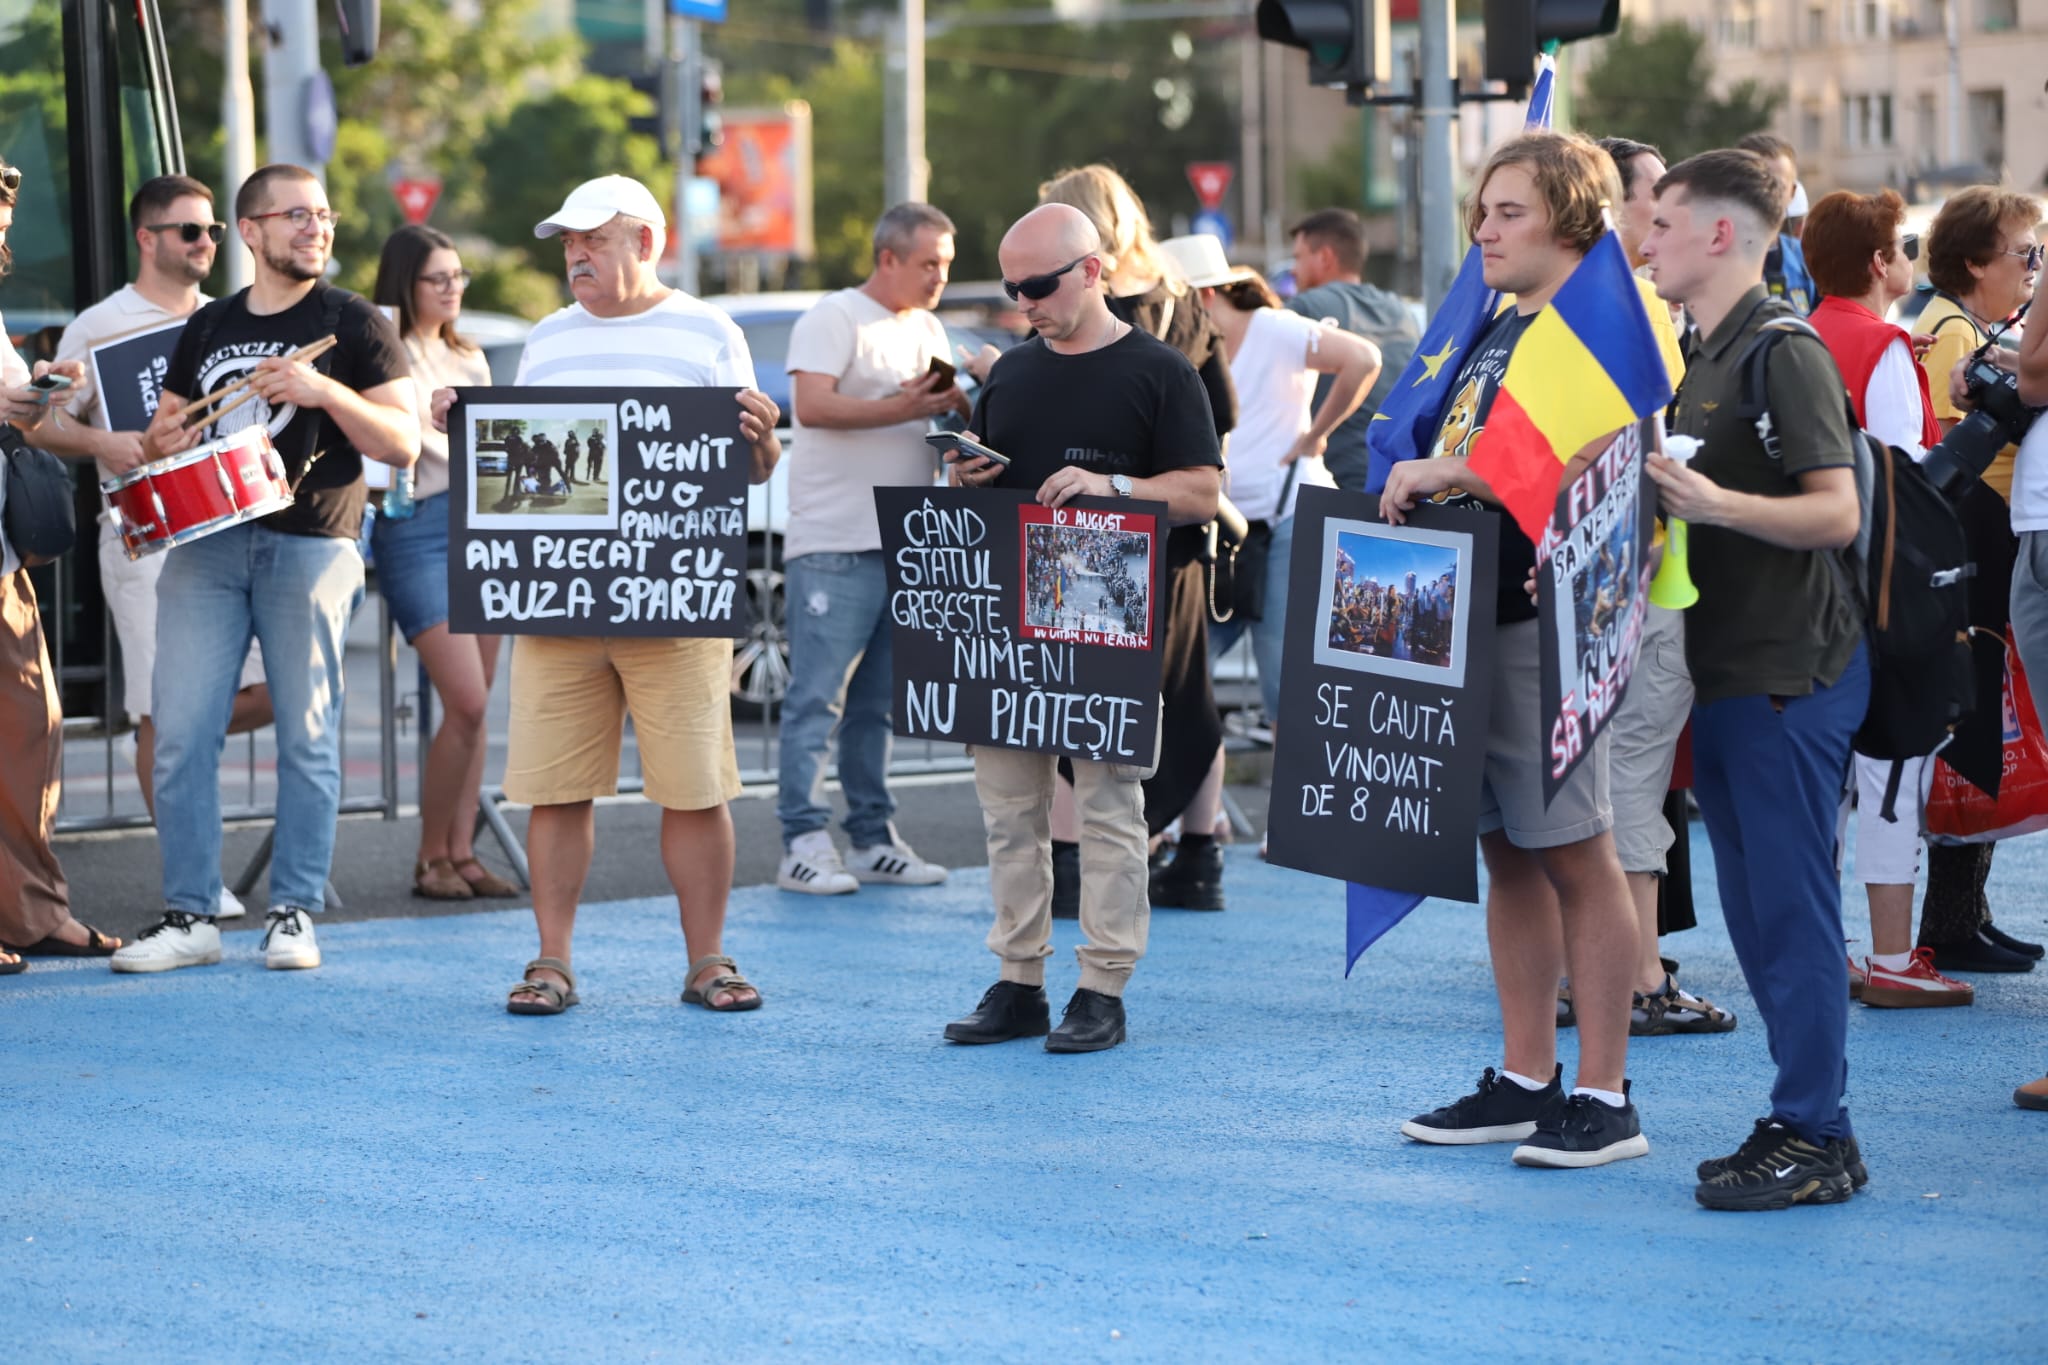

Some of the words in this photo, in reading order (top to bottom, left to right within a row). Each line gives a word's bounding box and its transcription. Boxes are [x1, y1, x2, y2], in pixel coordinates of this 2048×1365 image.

[137, 366, 159, 417] TACE.
[619, 399, 671, 431] AM
[637, 433, 734, 472] VENIT
[623, 478, 665, 506] CU
[672, 481, 704, 508] O
[620, 496, 745, 540] PANCARTĂ
[903, 497, 986, 548] CÂND
[1053, 508, 1067, 525] 10
[1075, 510, 1126, 531] AUGUST
[465, 539, 519, 571] AM
[533, 535, 655, 573] PLECAT
[670, 547, 725, 579] CU
[896, 546, 1002, 591] STATUL
[480, 576, 597, 621] BUZA
[607, 567, 740, 624] SPARTĂ
[954, 635, 1075, 685] NIMENI
[1084, 633, 1100, 645] NU
[906, 680, 957, 734] NU
[991, 684, 1143, 760] PLĂTEȘTE
[1315, 683, 1353, 729] SE
[1370, 691, 1455, 746] CAUTĂ
[1325, 741, 1443, 793] VINOVAT.
[1301, 784, 1335, 816] DE
[1350, 786, 1370, 822] 8
[1385, 797, 1441, 837] ANI.
